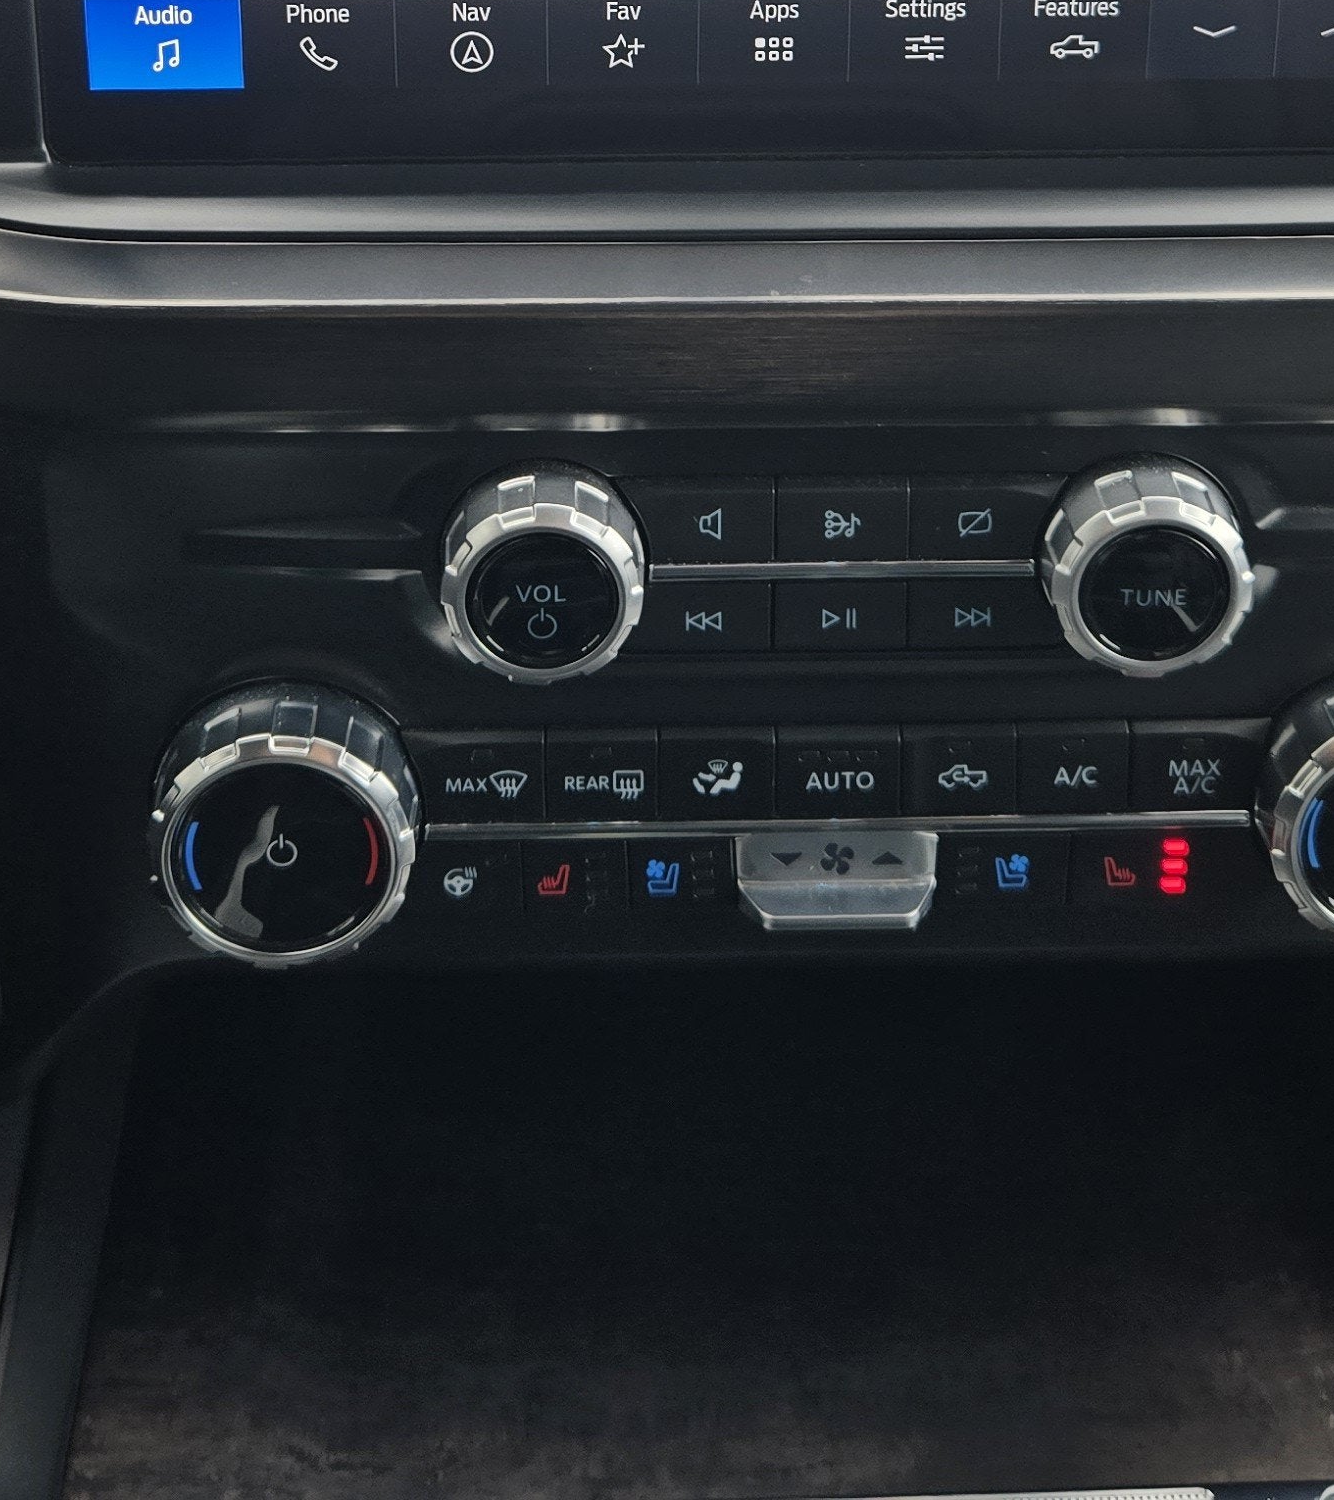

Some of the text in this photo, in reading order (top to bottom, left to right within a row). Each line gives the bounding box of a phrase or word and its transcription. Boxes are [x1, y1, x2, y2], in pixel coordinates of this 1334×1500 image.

[134, 6, 193, 26] Audio
[286, 4, 350, 24] Phone
[453, 3, 491, 21] Nav
[606, 2, 641, 20] Fav
[750, 0, 800, 23] Apps
[515, 584, 566, 603] VOL
[1120, 588, 1187, 607] TUNE
[1054, 765, 1097, 786] A/C
[1168, 760, 1221, 777] MAX
[445, 776, 488, 793] MAX
[564, 775, 610, 792] REAR
[805, 770, 875, 791] AUTO
[1173, 777, 1216, 796] A/C
